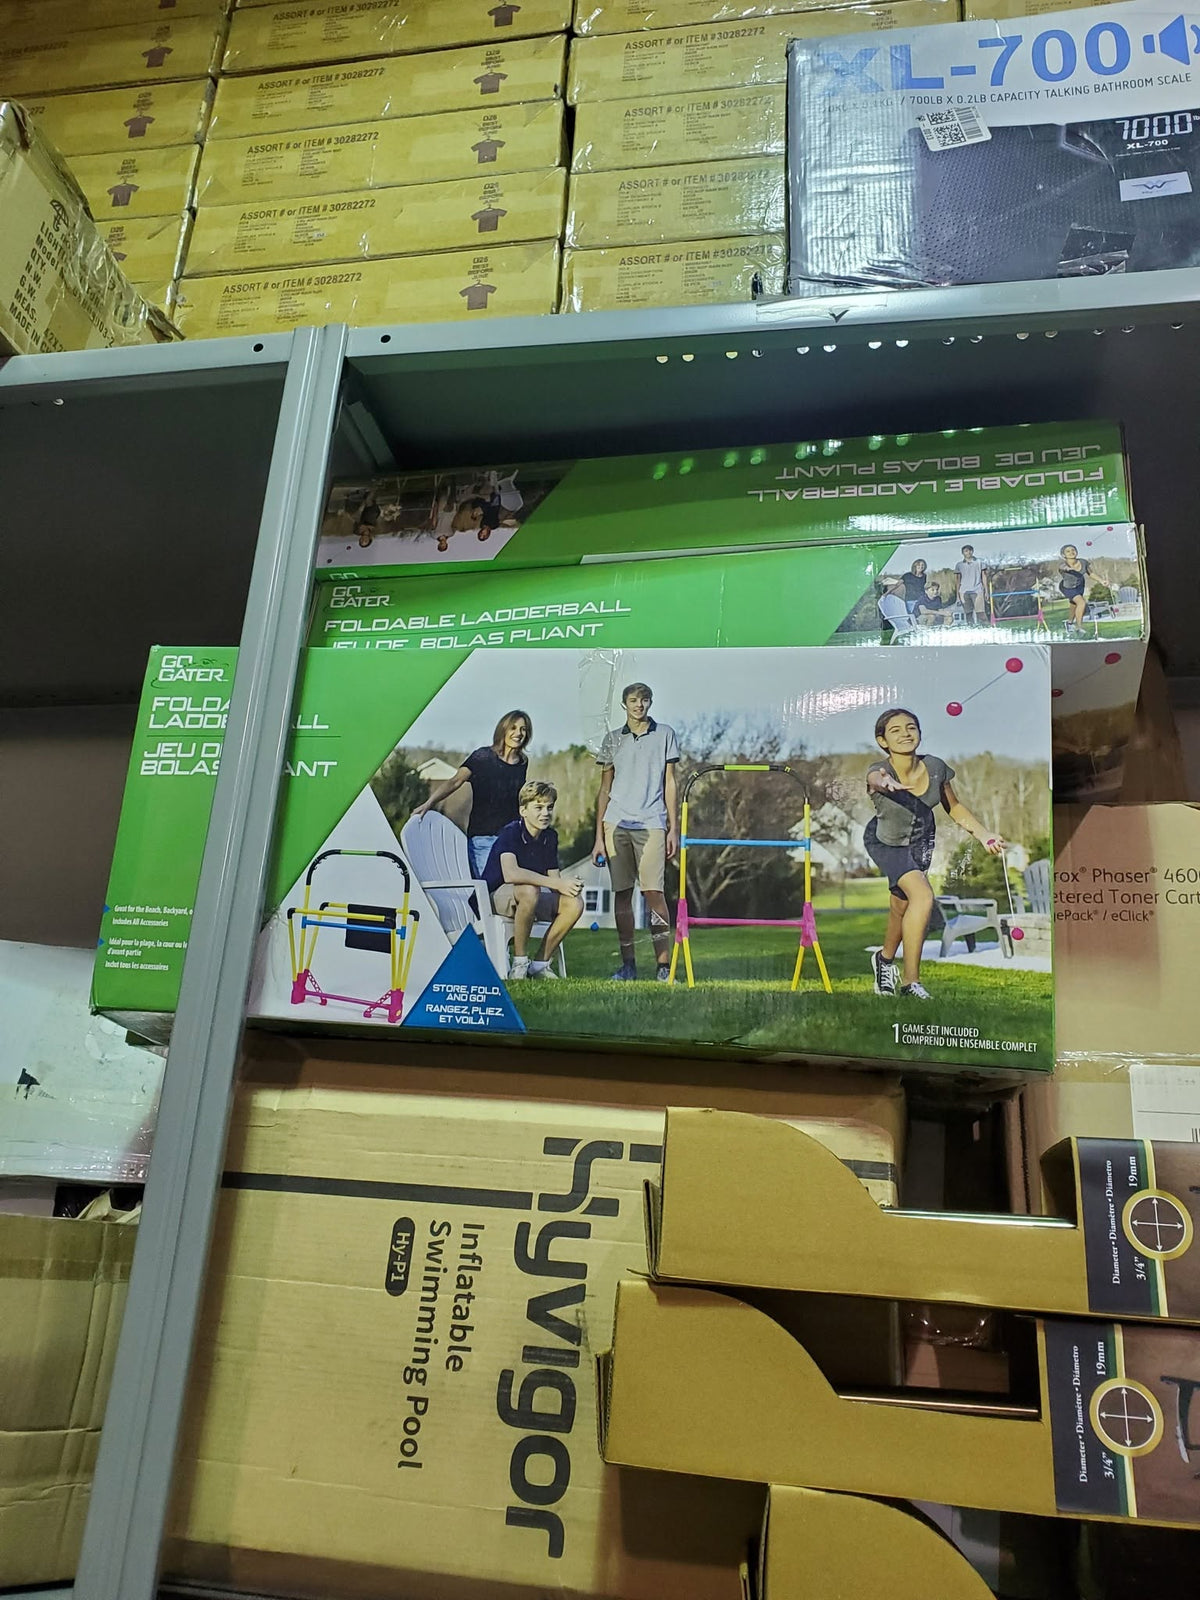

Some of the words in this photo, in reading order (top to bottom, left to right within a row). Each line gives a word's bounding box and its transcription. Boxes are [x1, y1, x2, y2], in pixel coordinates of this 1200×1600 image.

[273, 9, 307, 21] ASSORT
[327, 5, 348, 14] ITEM
[624, 39, 664, 50] ASSORT
[685, 34, 708, 43] ITEM
[815, 22, 1131, 96] XL-700
[258, 78, 292, 90] ASSORT
[312, 74, 333, 83] ITEM
[910, 95, 943, 105] 700LB
[946, 96, 954, 104] X
[957, 94, 986, 104] 0.2LB
[990, 89, 1041, 102] CAPACITY
[1044, 85, 1090, 99] TALKING
[1094, 77, 1153, 94] BATHROOM
[1157, 73, 1192, 85] SCALE
[624, 106, 663, 118] ASSORT
[687, 102, 711, 111] ITEM
[247, 142, 283, 154] ASSORT
[304, 138, 325, 148] ITEM
[334, 132, 379, 145] 30282272
[1126, 139, 1169, 150] XL-700
[619, 179, 660, 191] ASSORT
[683, 175, 707, 184] ITEM
[240, 209, 277, 221] ASSORT
[298, 205, 320, 215] ITEM
[329, 199, 376, 211] 30282272
[30, 248, 47, 274] QTY:
[35, 234, 60, 271] Model
[619, 255, 661, 266] ASSORT
[686, 250, 710, 260] ITEM
[223, 283, 261, 294] ASSORT
[282, 278, 305, 288] ITEM
[314, 272, 362, 286] 30282272
[14, 289, 38, 324] MEAS:
[9, 302, 31, 334] MADE
[30, 329, 41, 346] IN
[995, 450, 1035, 467] DE
[1043, 444, 1100, 464] JEU
[775, 462, 876, 480] PLIANT
[883, 456, 980, 474] BOLAS
[944, 467, 1104, 492] FOLDABLE
[747, 480, 937, 502] LADDERBALL
[330, 595, 390, 608] GATER
[324, 614, 456, 632] FOLDABLE
[460, 600, 632, 626] LADDERBALL
[420, 632, 504, 649] BOLAS
[509, 623, 604, 643] PLIANT
[161, 655, 193, 668] GO
[158, 668, 225, 682] GATER
[152, 697, 231, 712] FOLD
[143, 742, 195, 758] JEU
[200, 742, 223, 758] D
[1163, 868, 1200, 883] 460
[1053, 889, 1104, 904] etered
[1108, 889, 1160, 904] Toner
[1165, 890, 1200, 905] Cart
[1103, 910, 1107, 921] /
[432, 984, 470, 995] STORE,
[471, 986, 501, 996] FOLD,
[469, 994, 486, 1003] GO!
[425, 1004, 470, 1015] RANGEZ,
[471, 1006, 504, 1017] PLIEZ,
[439, 1015, 454, 1023] ET
[891, 1023, 899, 1044] 1
[902, 1023, 925, 1034] GAME
[926, 1025, 940, 1035] SET
[941, 1026, 979, 1038] INCLUDED
[902, 1034, 945, 1047] COMPREND
[946, 1037, 958, 1048] UN
[959, 1038, 1000, 1050] ENSEMBLE
[1001, 1041, 1037, 1053] COMPLET
[1106, 1160, 1114, 1197] Diámetro
[1128, 1156, 1138, 1187] 19mm
[388, 1231, 412, 1283] Hy-P1
[1112, 1246, 1120, 1284] Diameter
[403, 1220, 452, 1387] Swimming
[445, 1222, 485, 1373] Inflatable
[1096, 1342, 1106, 1376] 19mm
[397, 1395, 429, 1470] Pool
[1079, 1440, 1088, 1483] Diameter
